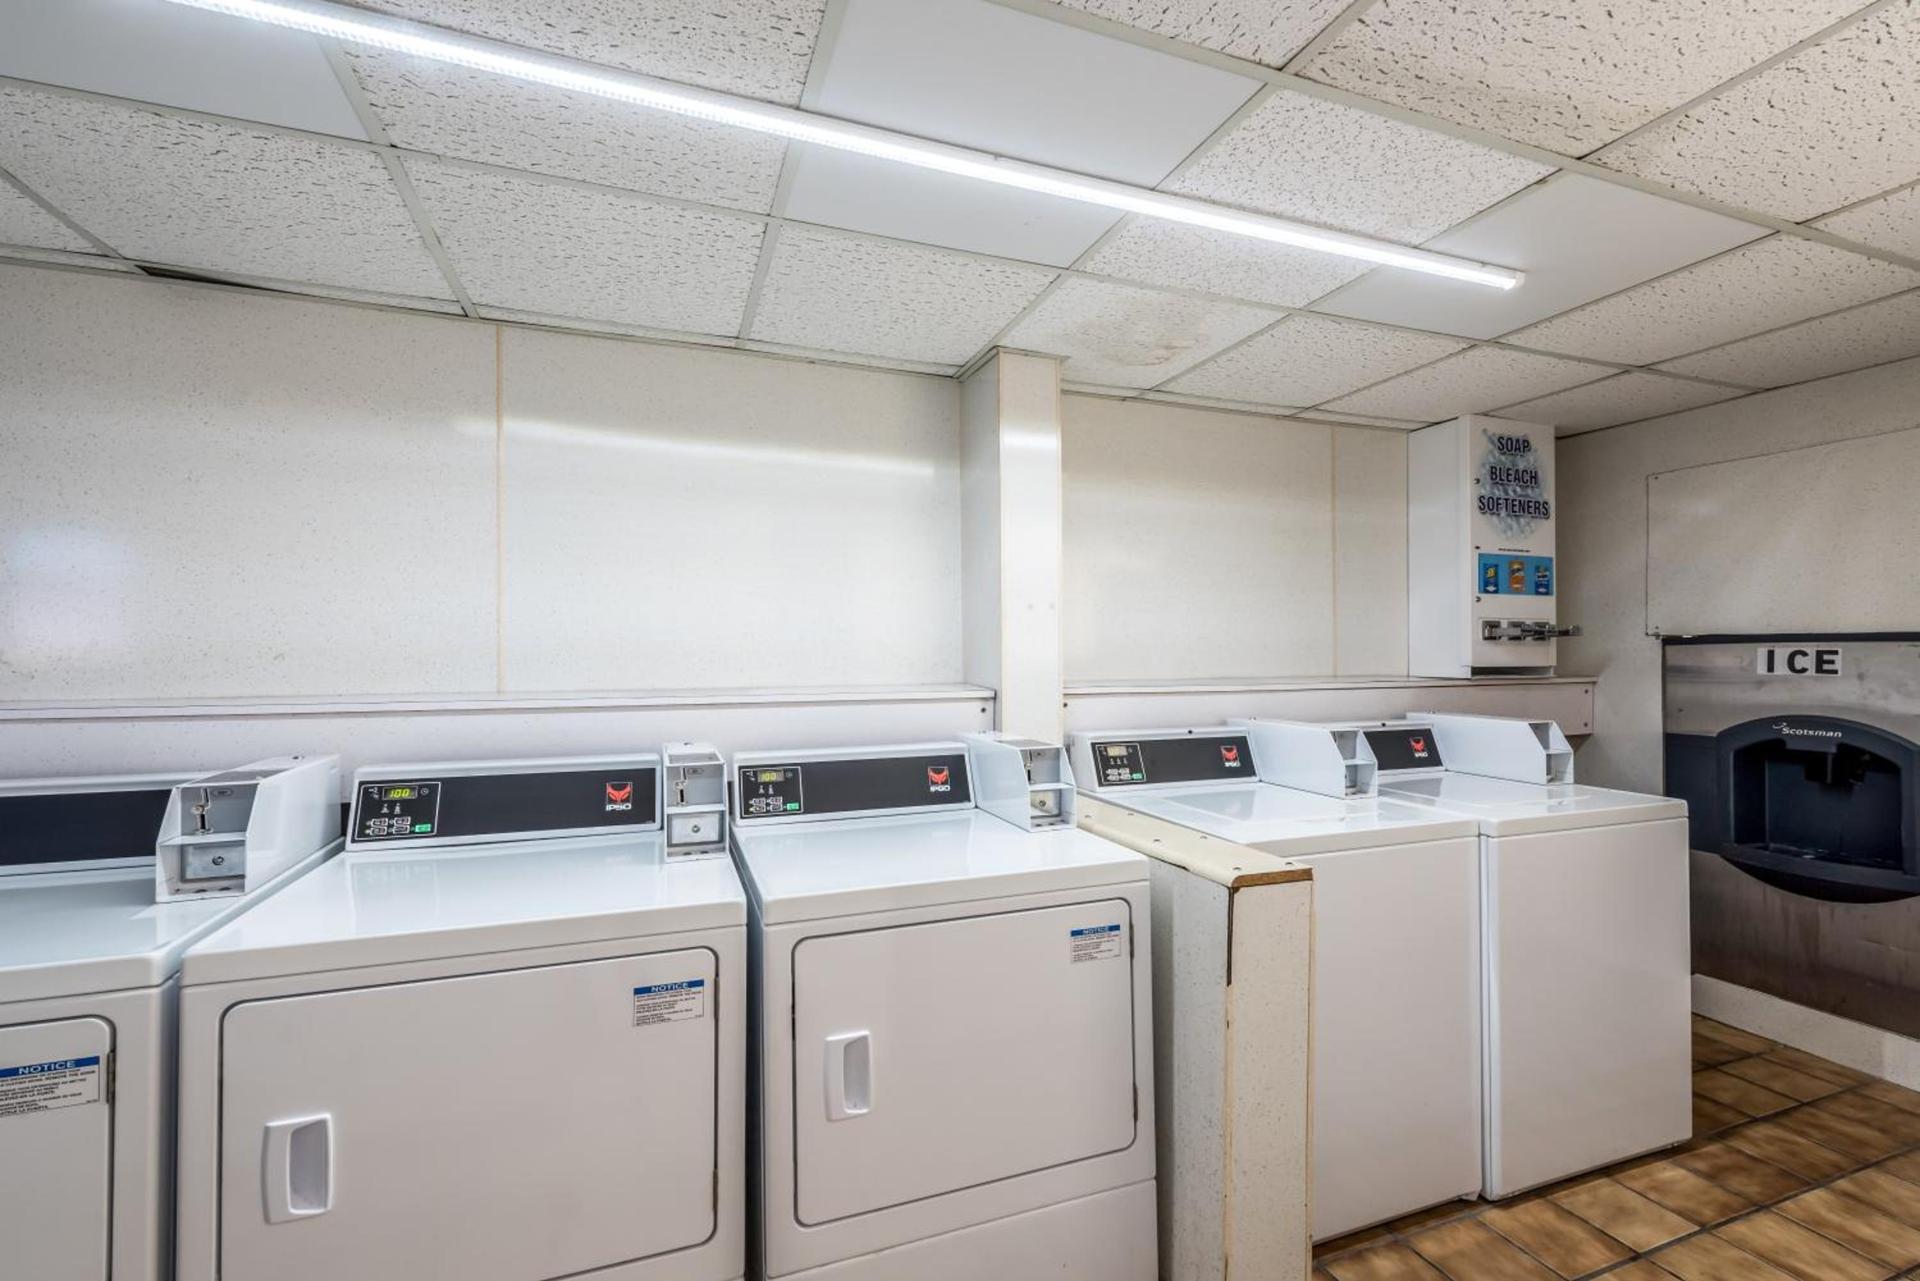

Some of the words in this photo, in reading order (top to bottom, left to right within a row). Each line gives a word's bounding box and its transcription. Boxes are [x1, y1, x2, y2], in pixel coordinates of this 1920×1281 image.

[1497, 436, 1530, 454] SOAP
[1490, 465, 1538, 485] BLEACH
[1478, 496, 1548, 517] SOFTENERS
[1767, 649, 1839, 675] ICE
[1781, 727, 1842, 738] Scotsman
[389, 788, 410, 798] 100
[605, 803, 632, 812] IPSO
[651, 982, 689, 992] NOTICE
[18, 1061, 76, 1074] NOTICE
